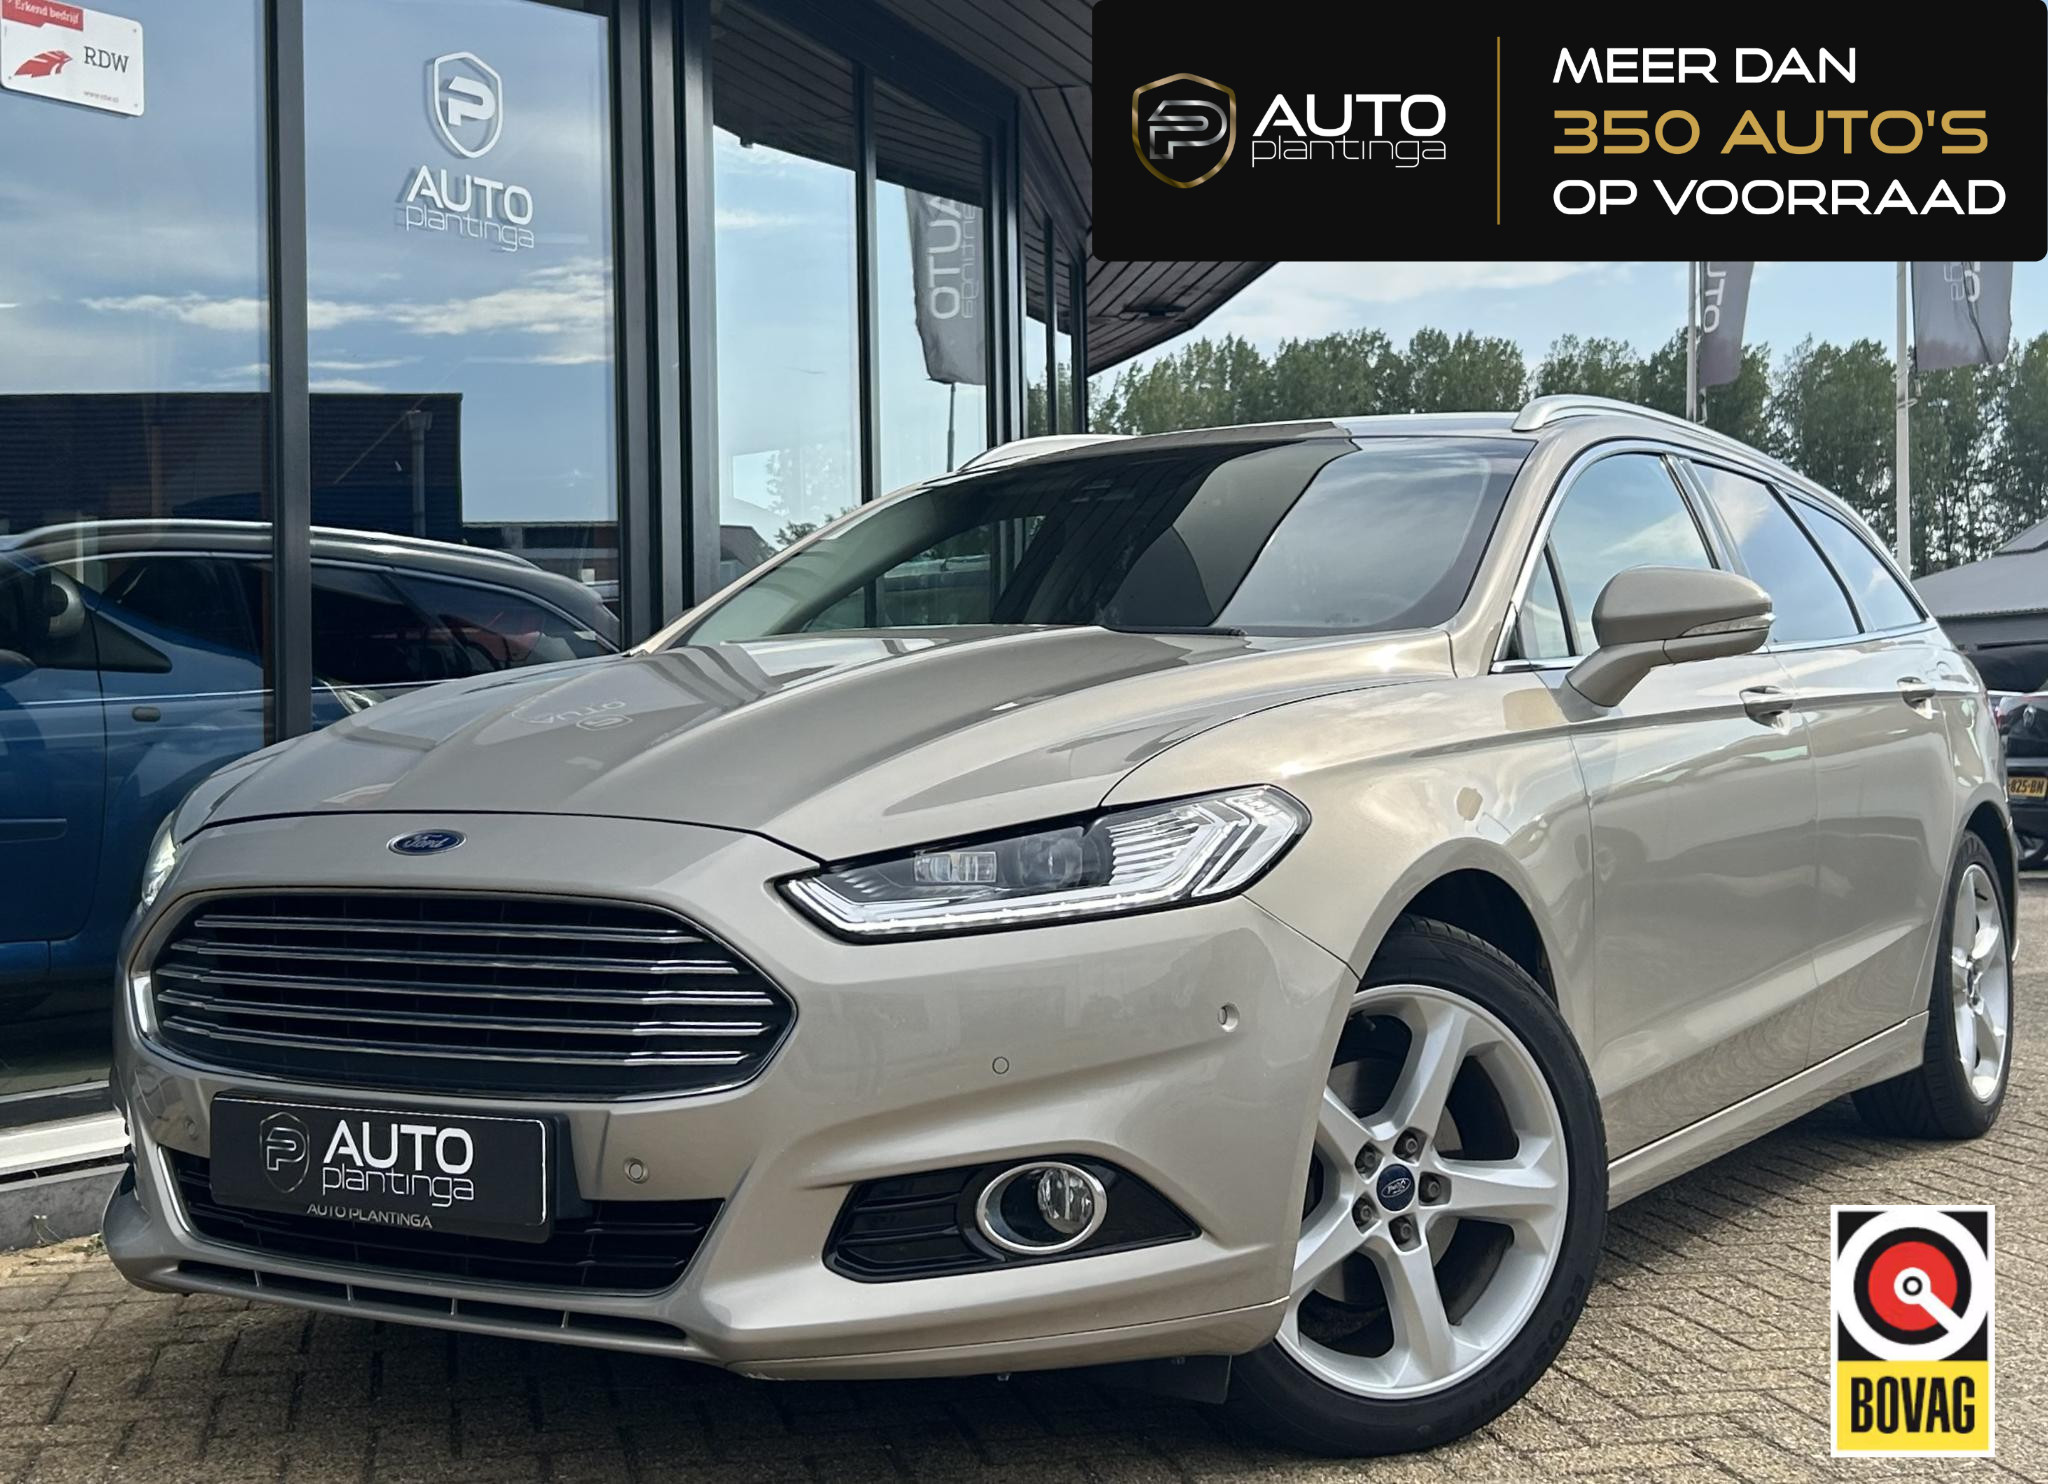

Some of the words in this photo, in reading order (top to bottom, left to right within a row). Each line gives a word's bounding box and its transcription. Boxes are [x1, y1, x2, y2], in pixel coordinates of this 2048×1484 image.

[49, 7, 80, 24] bedrijf
[84, 45, 129, 73] RDW
[406, 165, 534, 226] AUTO
[406, 204, 535, 252] plantinga
[401, 833, 451, 849] Ford
[323, 1119, 474, 1175] AUTO
[322, 1163, 474, 1208] plantinga
[307, 1203, 346, 1218] AUTO
[349, 1208, 433, 1229] PLANTINGA
